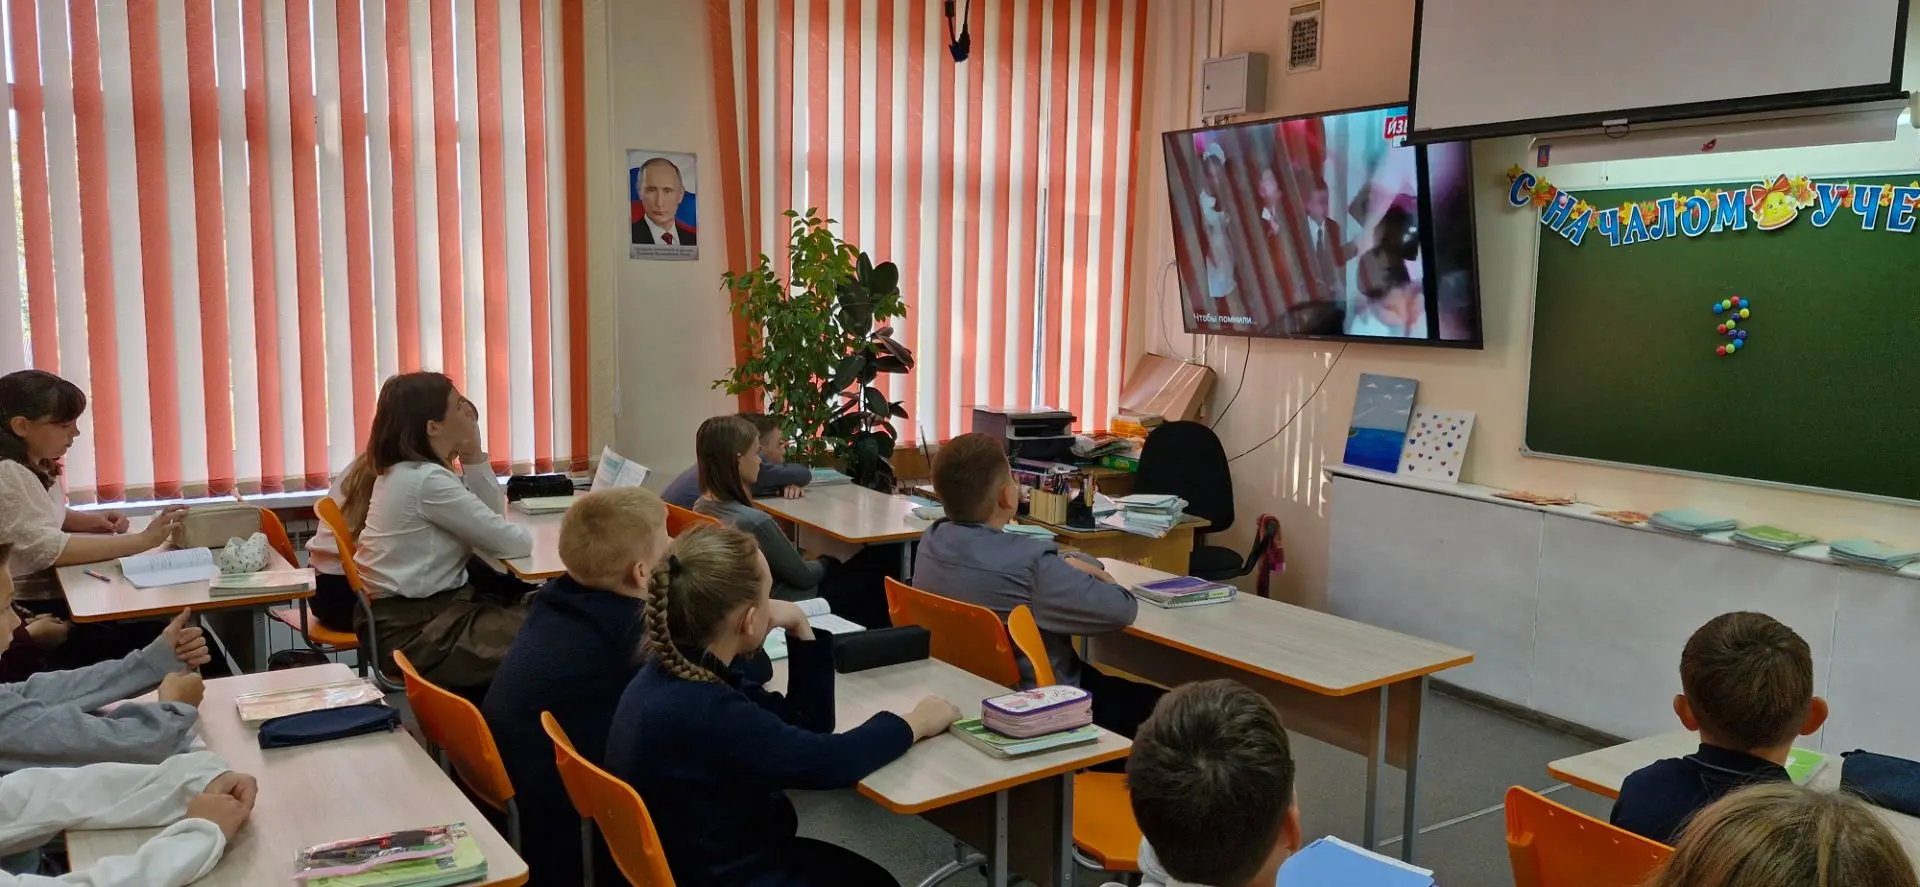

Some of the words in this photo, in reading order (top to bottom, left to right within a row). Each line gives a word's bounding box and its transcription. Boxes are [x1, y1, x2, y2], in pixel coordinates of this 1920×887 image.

[1509, 171, 1536, 207] С
[1540, 188, 1748, 247] НАЧАЛОМ
[1811, 183, 1920, 233] УЧЕ
[1193, 313, 1217, 323] Чтобы
